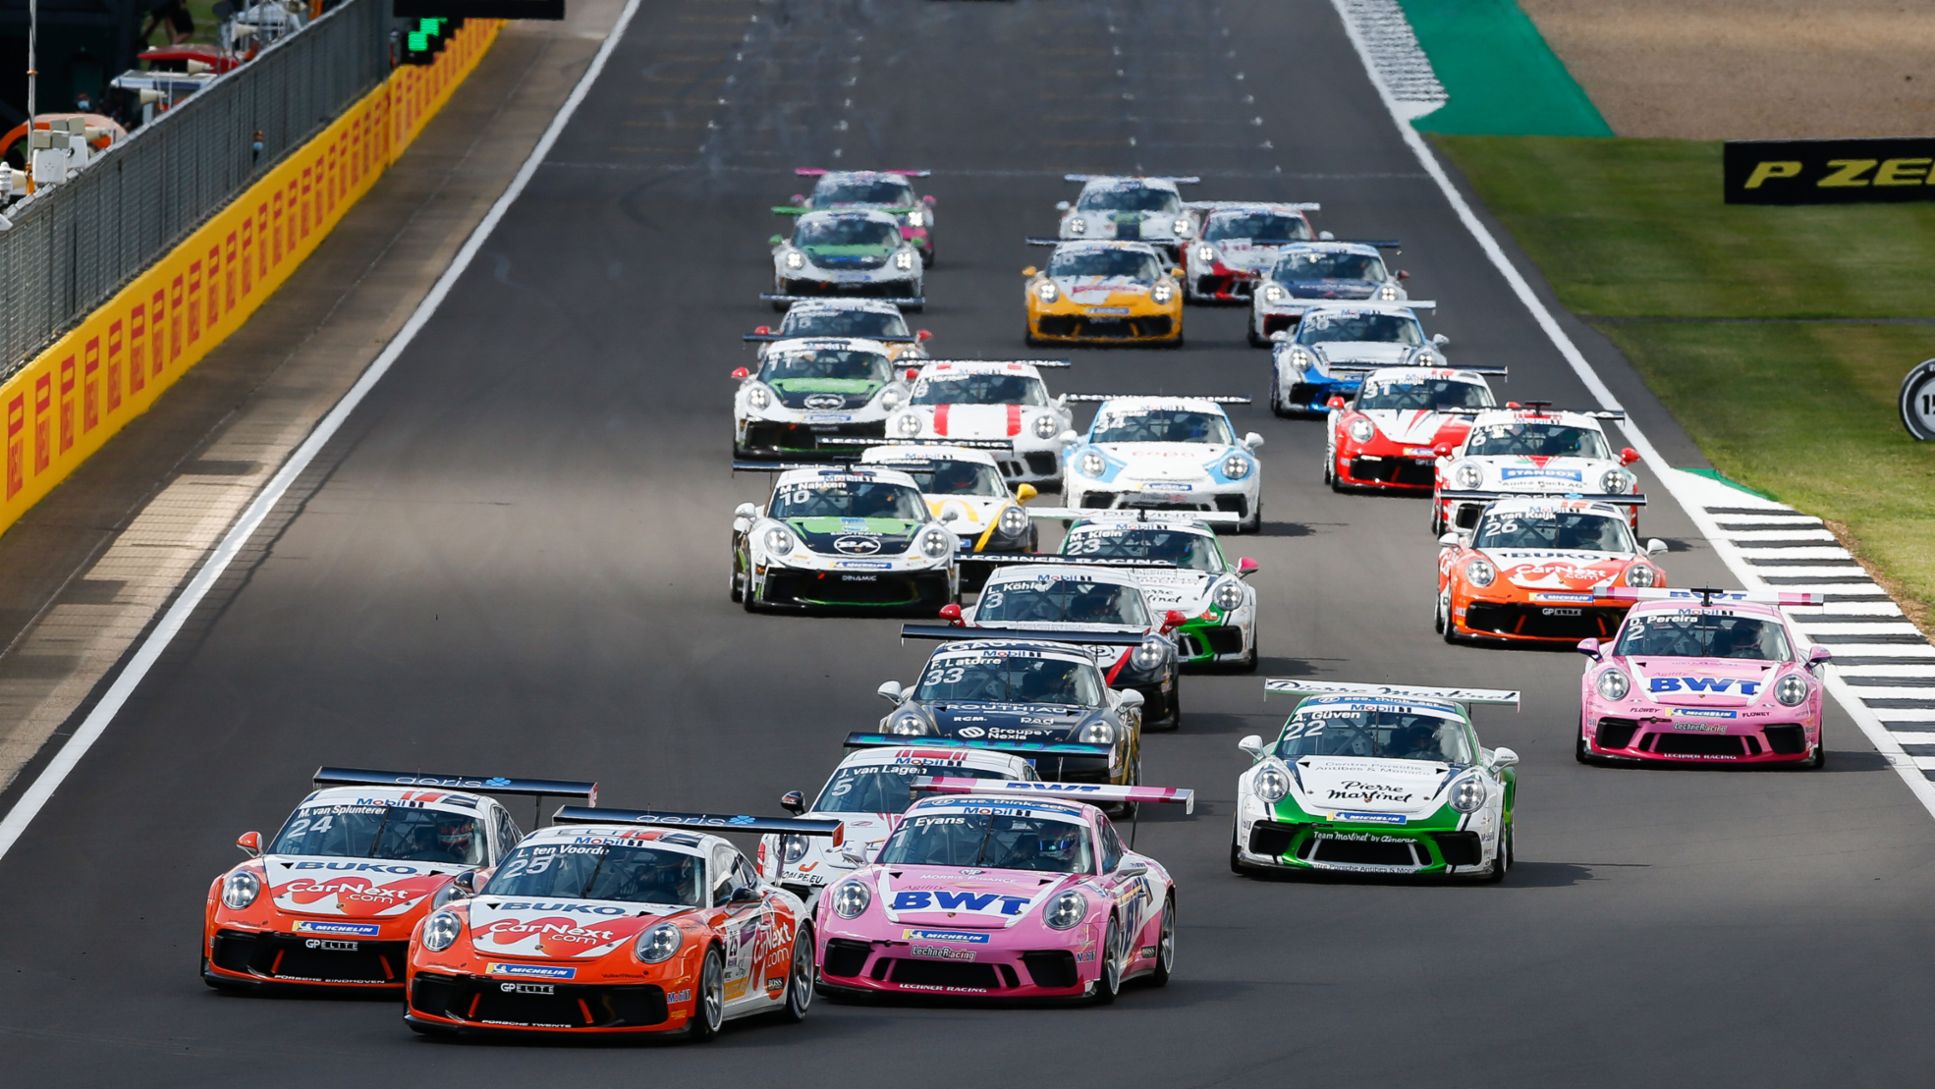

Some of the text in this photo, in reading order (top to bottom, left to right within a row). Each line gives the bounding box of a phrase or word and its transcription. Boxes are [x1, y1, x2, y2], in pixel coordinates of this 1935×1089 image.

[1744, 157, 1935, 189] P ZE
[1507, 469, 1577, 478] STANDOX
[779, 486, 796, 495] M.
[779, 490, 811, 507] 10
[1486, 520, 1518, 536] 26
[1069, 530, 1123, 543] M. Klein
[1067, 540, 1101, 555] 23
[1076, 557, 1171, 566] RACING
[1511, 552, 1600, 560] BUKO
[1515, 564, 1606, 577] CarNext
[1038, 574, 1077, 582] Mobil
[987, 586, 1000, 595] L.
[985, 592, 1004, 609] 3
[1678, 608, 1720, 616] Mobil
[1630, 615, 1698, 626] D. Pereira
[1627, 625, 1645, 641] 2
[983, 650, 1026, 658] Mobil
[931, 655, 1002, 669] F. Latorre
[924, 668, 965, 686] 33
[1650, 677, 1762, 696] BWT
[946, 704, 1067, 713] ROUTHIAU
[1351, 704, 1395, 713] Mobil
[1685, 710, 1732, 718] MICHELIN
[1292, 711, 1361, 723] A. Güven
[1283, 720, 1327, 741] 22
[896, 757, 944, 766] Mobil
[838, 764, 927, 779] J. van Lagen
[831, 777, 854, 797] 5
[1341, 780, 1403, 793] Pierre
[1327, 789, 1413, 803] Martinet
[356, 798, 406, 808] Mobil
[313, 807, 330, 815] van
[331, 805, 387, 816] Splunterer
[963, 807, 1012, 816] Mobil
[287, 815, 333, 839] 24
[898, 816, 966, 830] J. Evans
[574, 836, 624, 846] Mobil
[1314, 831, 1334, 839] Team
[517, 844, 610, 857] L. ten Voorde
[295, 861, 418, 875] BUKO
[502, 857, 551, 880] 25
[287, 882, 409, 899] CarNext
[500, 902, 626, 916] BUKO
[894, 891, 1031, 916] BWT
[315, 924, 374, 933] MICHELIN
[489, 921, 614, 940] CarNext
[926, 932, 983, 941] MICHELIN
[510, 967, 568, 976] MICHELIN
[899, 983, 943, 991] LECHNER
